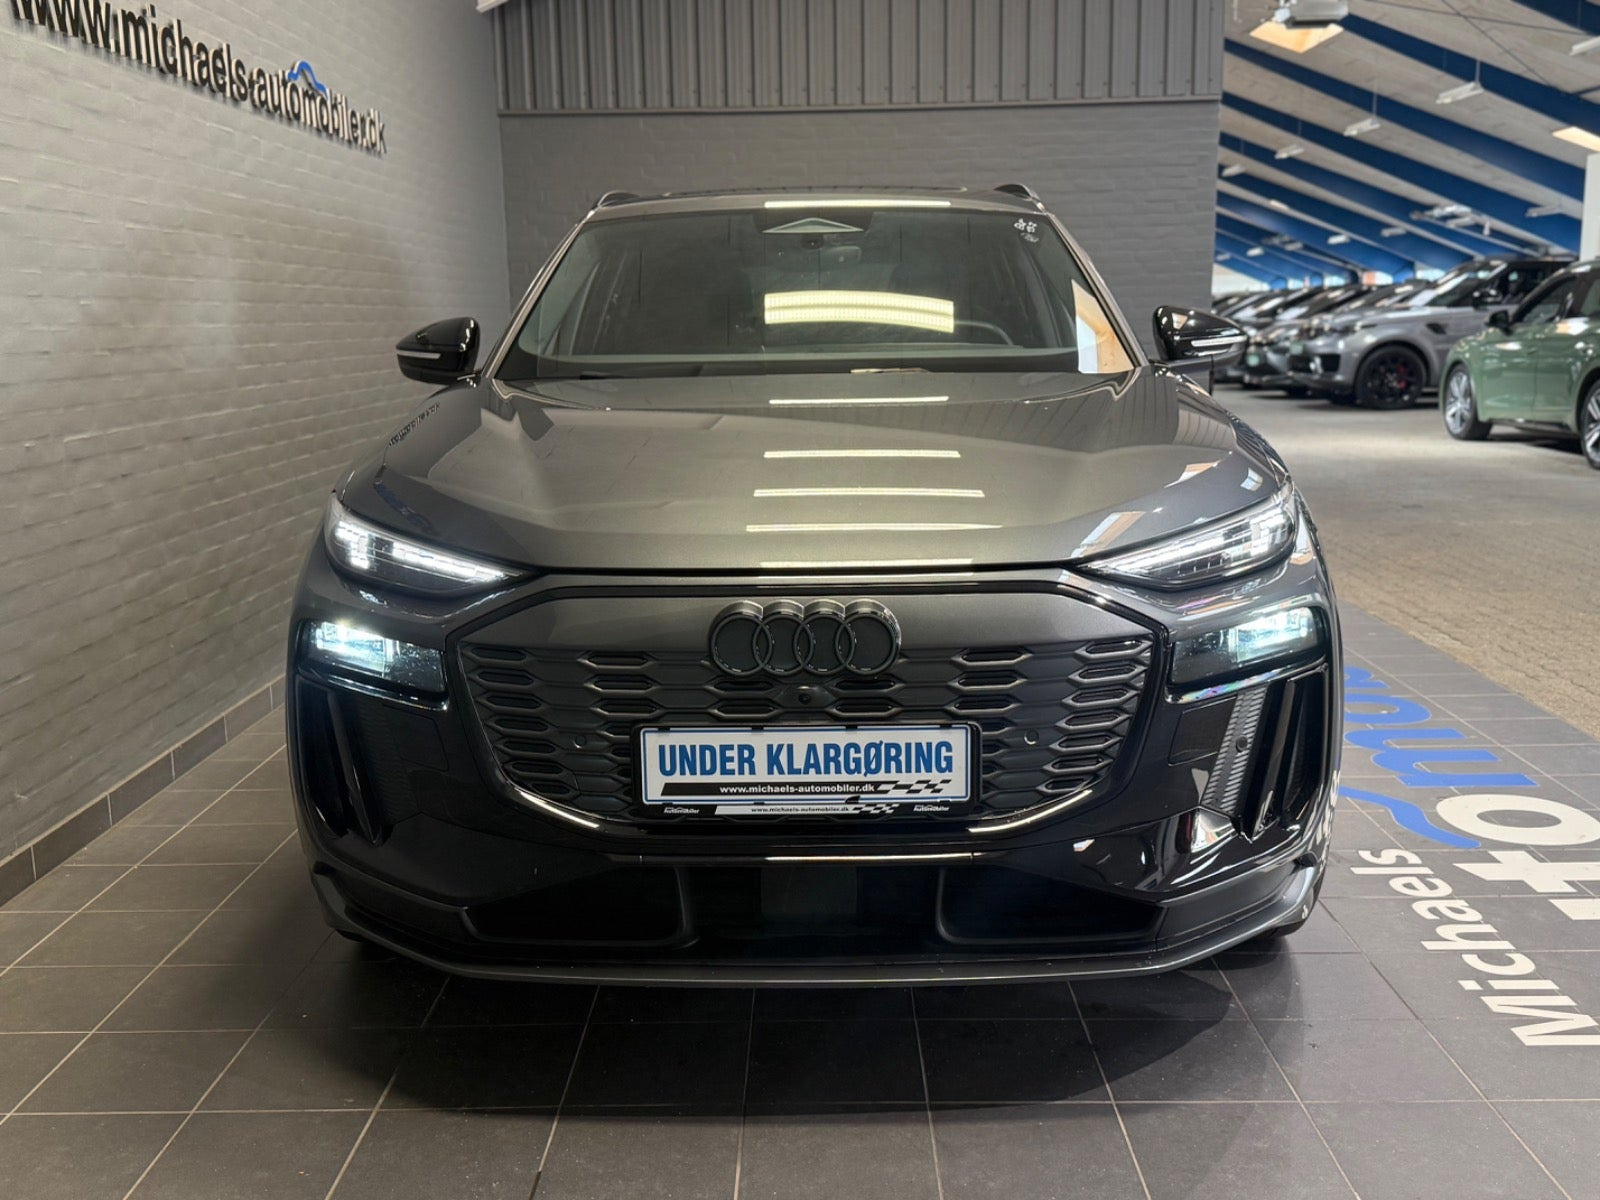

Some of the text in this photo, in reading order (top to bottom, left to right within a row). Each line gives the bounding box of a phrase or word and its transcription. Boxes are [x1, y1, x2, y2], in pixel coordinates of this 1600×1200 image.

[658, 740, 953, 777] UNDER KLARGØRING
[719, 783, 875, 794] www.michaels-automobiler.dk
[1350, 848, 1600, 1046] Michaels
